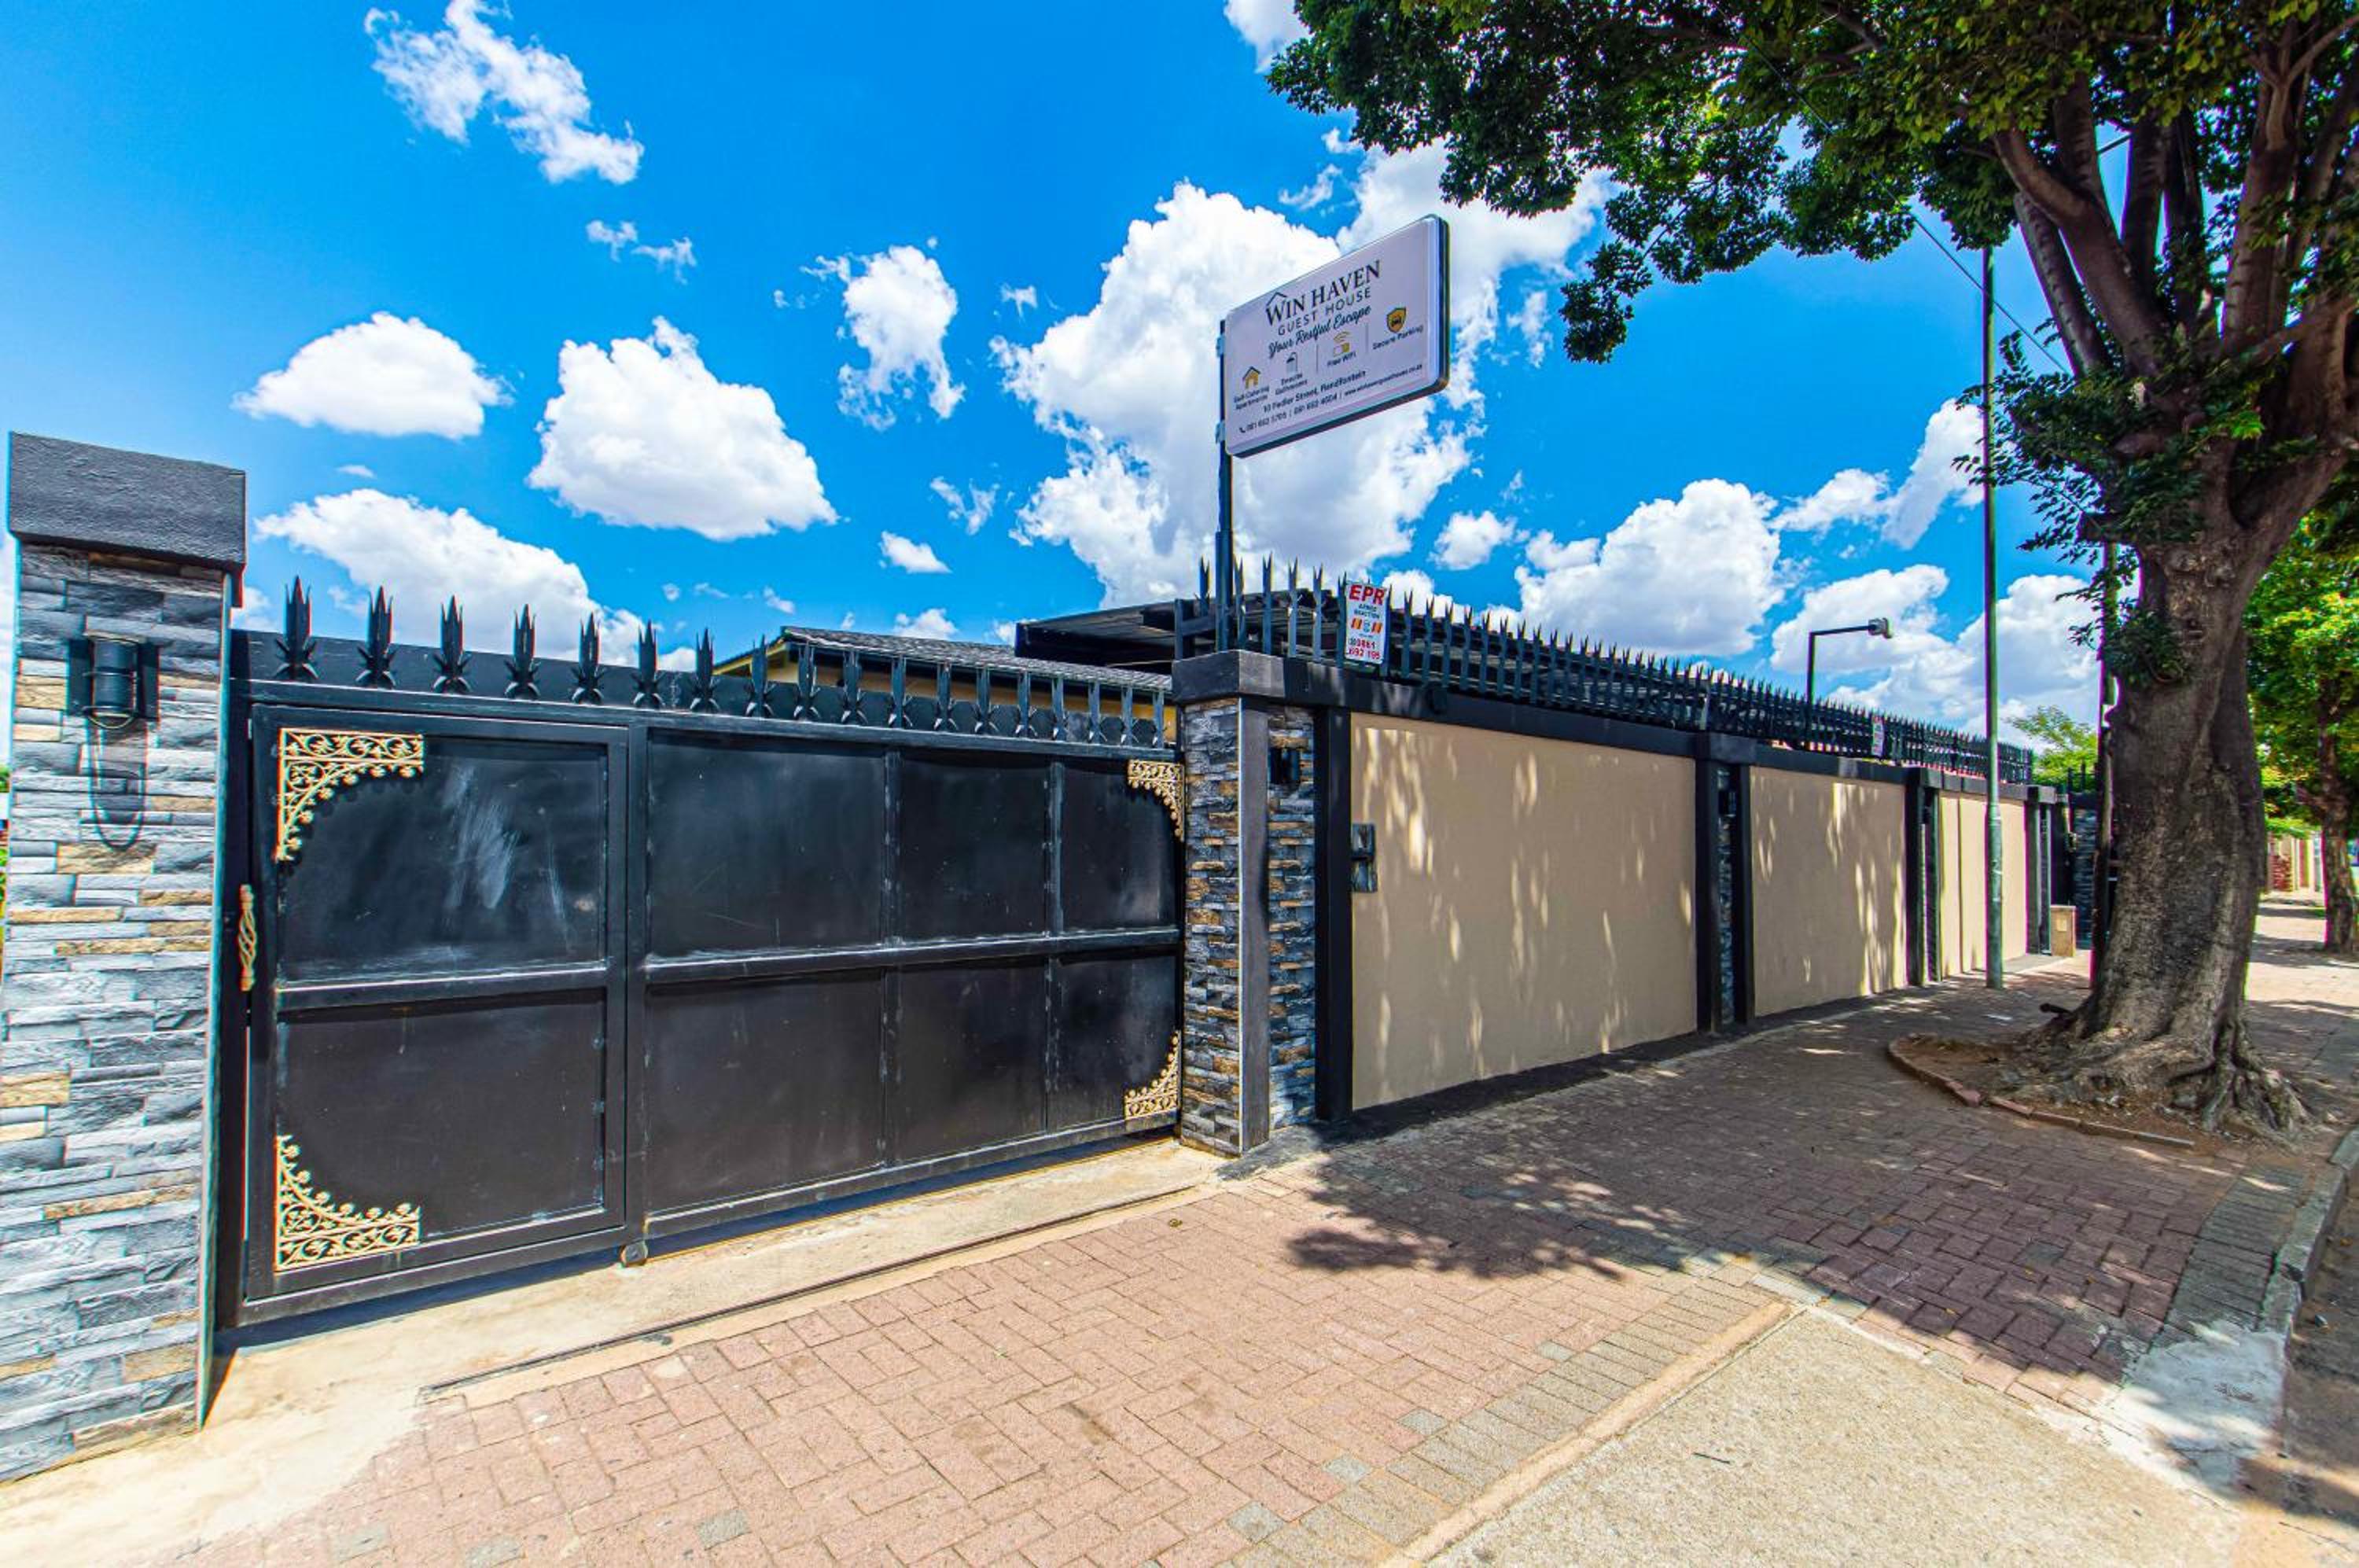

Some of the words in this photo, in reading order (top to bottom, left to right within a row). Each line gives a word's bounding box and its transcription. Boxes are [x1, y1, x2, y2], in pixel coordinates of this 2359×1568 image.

[1265, 295, 1305, 326] WIN
[1312, 259, 1381, 307] HAVEN
[1278, 310, 1318, 336] GUEST
[1326, 287, 1371, 315] HOUSE
[1268, 339, 1294, 359] Your
[1296, 319, 1330, 345] Restful
[1333, 305, 1371, 329] Escape
[1372, 337, 1396, 350] Secure
[1397, 325, 1423, 340] Parking
[1327, 358, 1341, 367] Free
[1349, 584, 1385, 605] EPR
